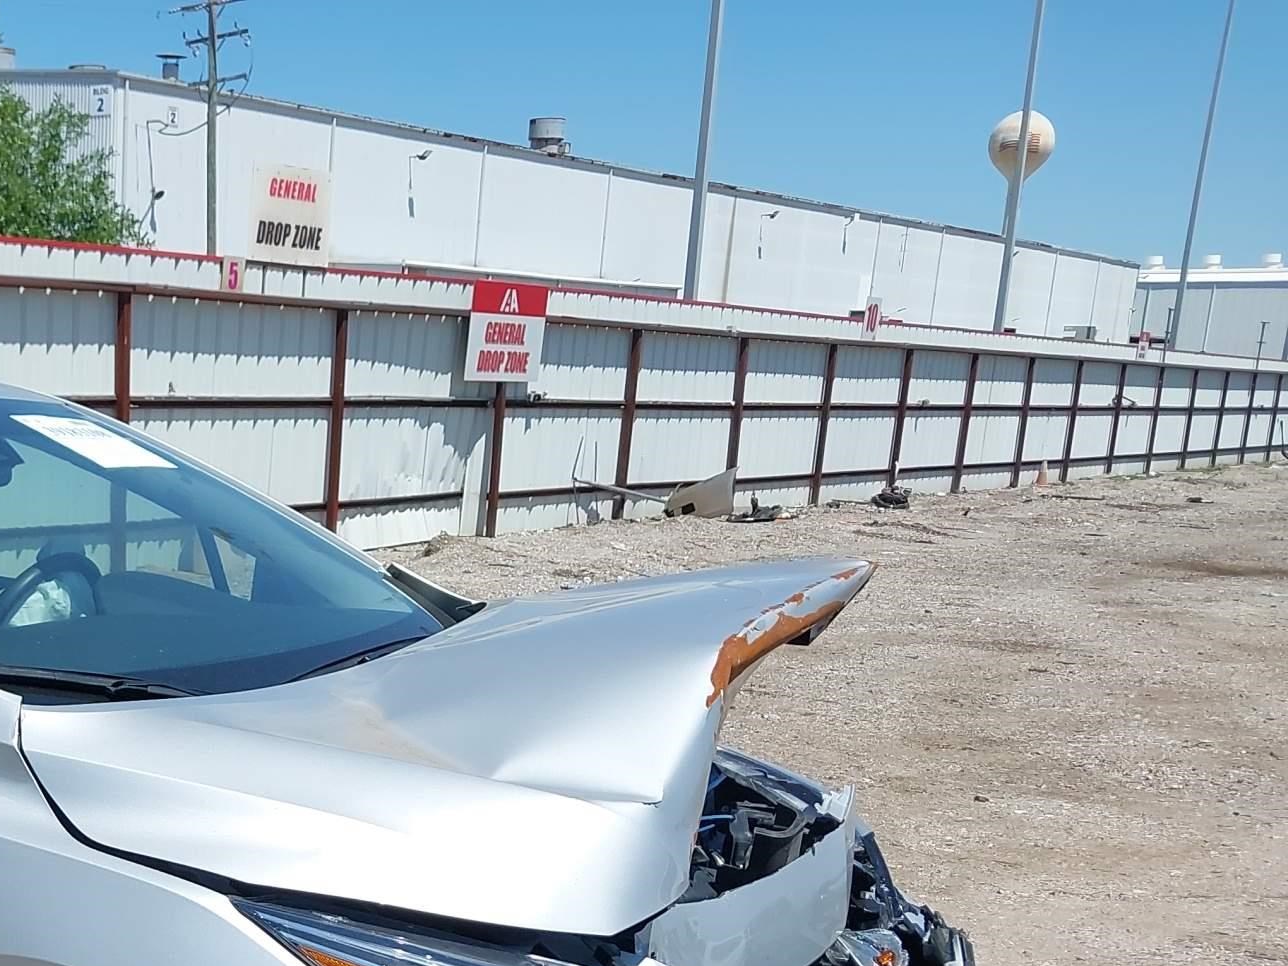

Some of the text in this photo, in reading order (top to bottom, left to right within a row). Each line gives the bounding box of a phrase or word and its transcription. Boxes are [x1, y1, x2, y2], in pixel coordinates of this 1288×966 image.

[97, 98, 104, 112] 2
[171, 113, 176, 124] 2
[269, 177, 317, 203] GENERAL
[256, 219, 323, 251] DROP ZONE
[228, 261, 238, 290] 5
[865, 303, 879, 333] 10
[485, 321, 527, 346] GENERAL
[476, 350, 530, 374] DROP ZONE
